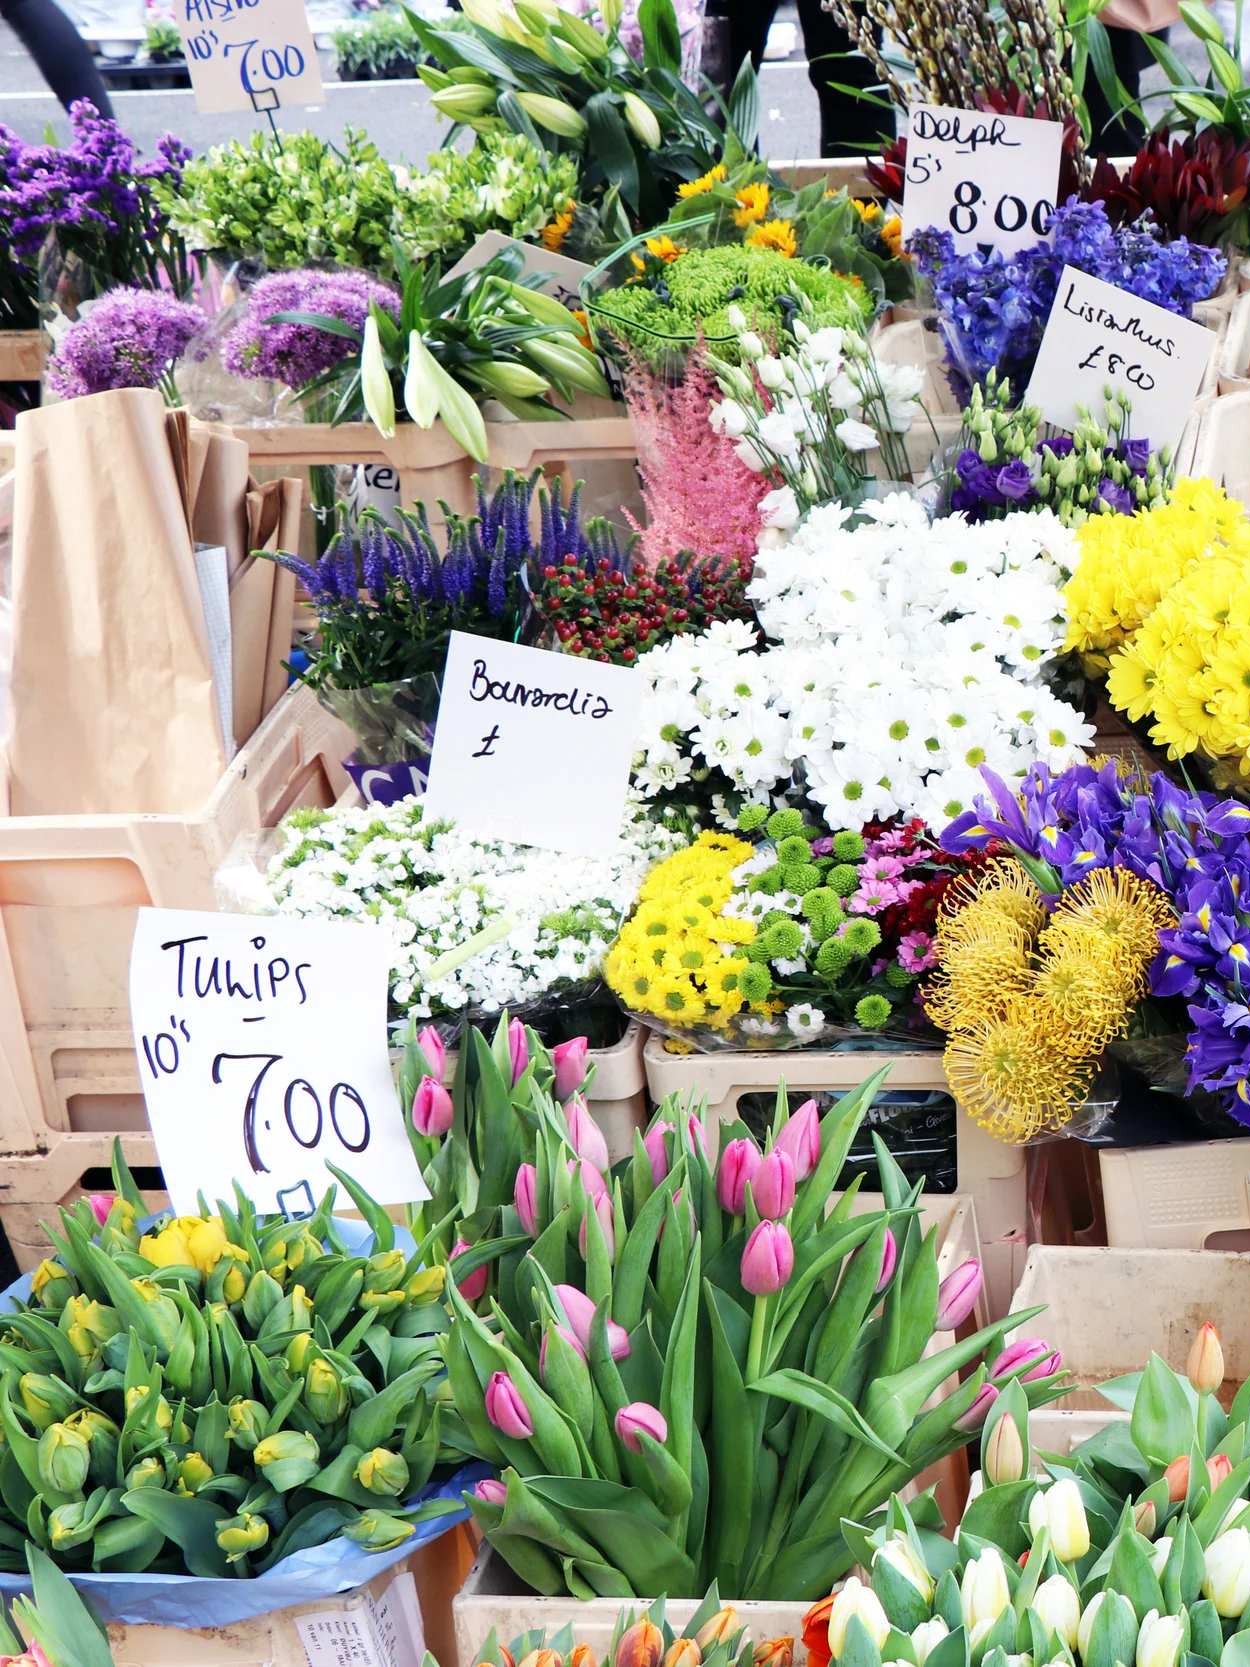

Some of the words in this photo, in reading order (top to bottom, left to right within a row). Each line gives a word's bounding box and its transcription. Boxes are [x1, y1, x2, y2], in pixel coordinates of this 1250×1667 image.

[223, 39, 305, 94] 7.00
[469, 659, 613, 719] Bouvardia
[160, 935, 312, 1005] Tulips
[141, 1014, 192, 1079] 10's
[211, 1052, 371, 1175] 7.00
